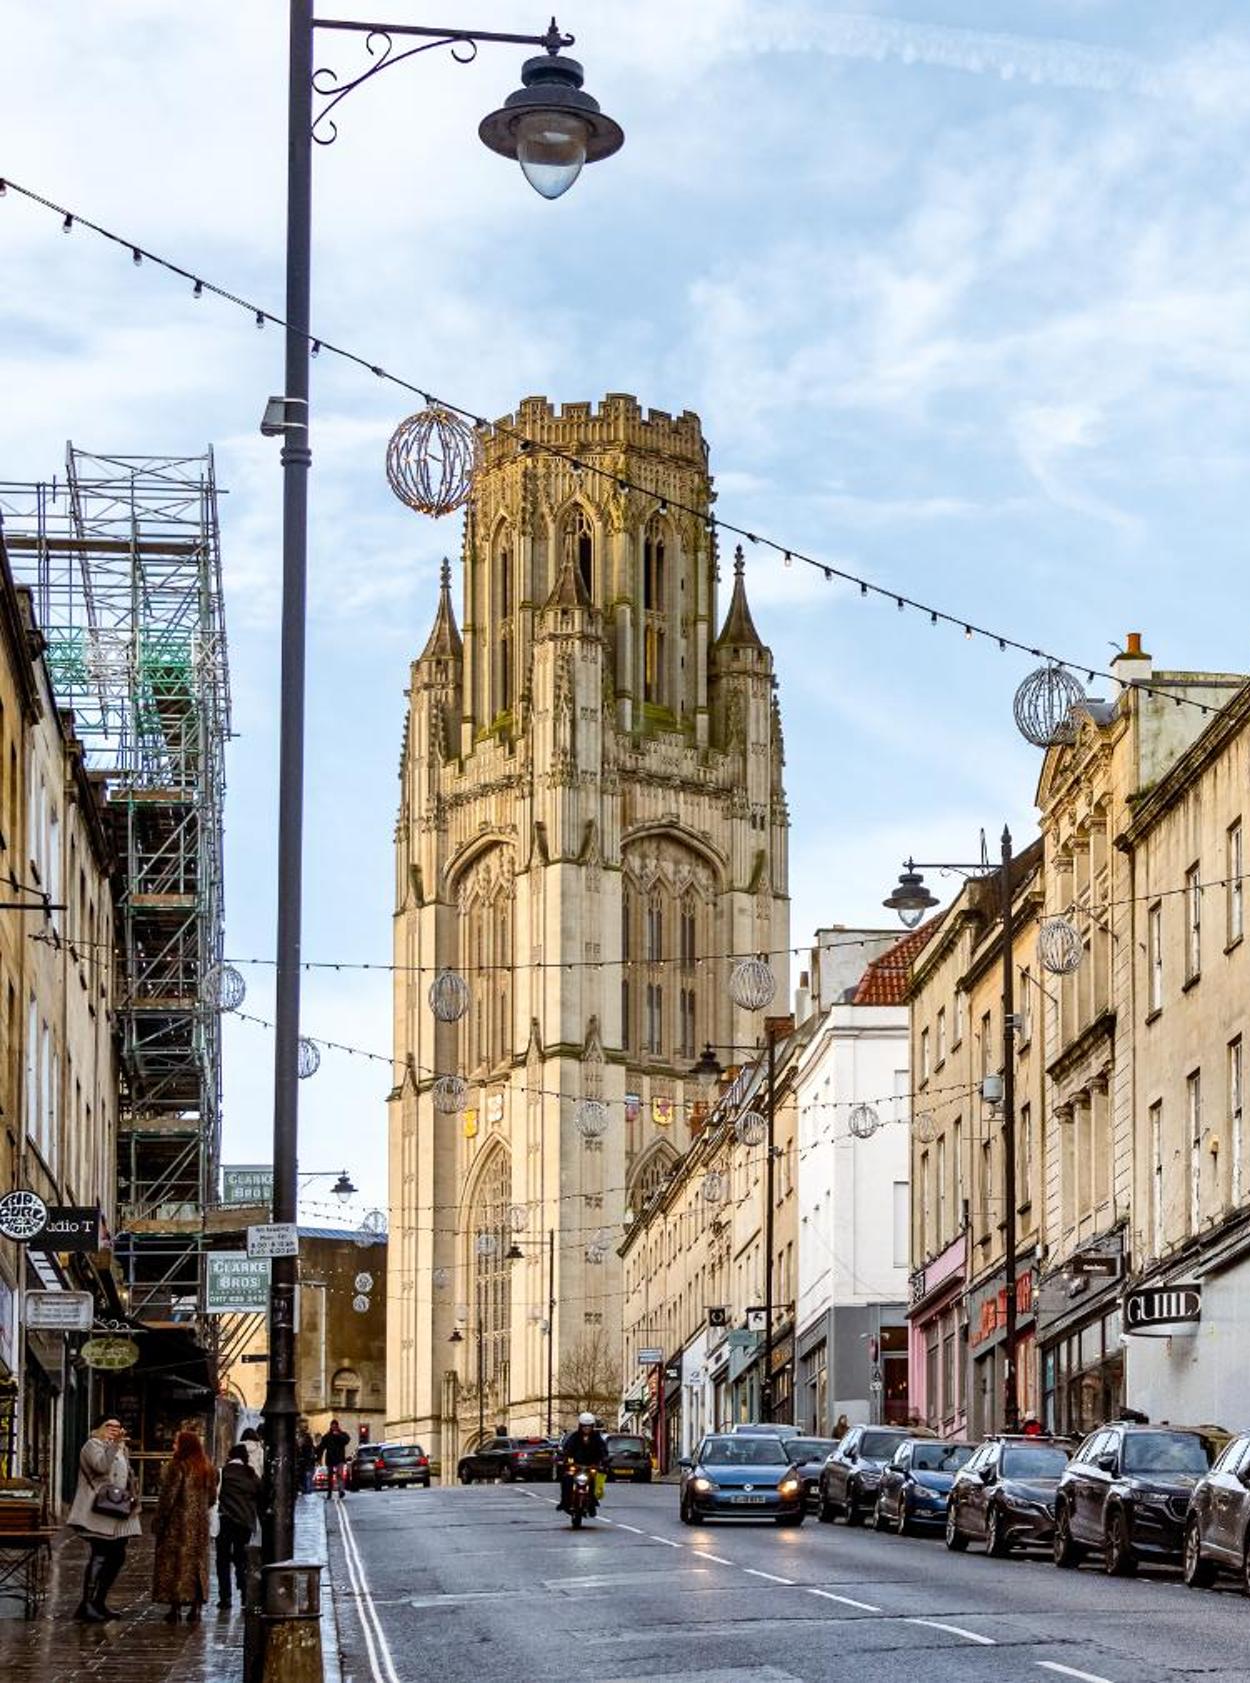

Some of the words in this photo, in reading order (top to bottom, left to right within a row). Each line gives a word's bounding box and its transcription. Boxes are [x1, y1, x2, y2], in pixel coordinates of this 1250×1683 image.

[46, 1219, 79, 1232] udio
[82, 1220, 94, 1233] T
[213, 1261, 267, 1273] CLARKE
[219, 1276, 258, 1289] BROS
